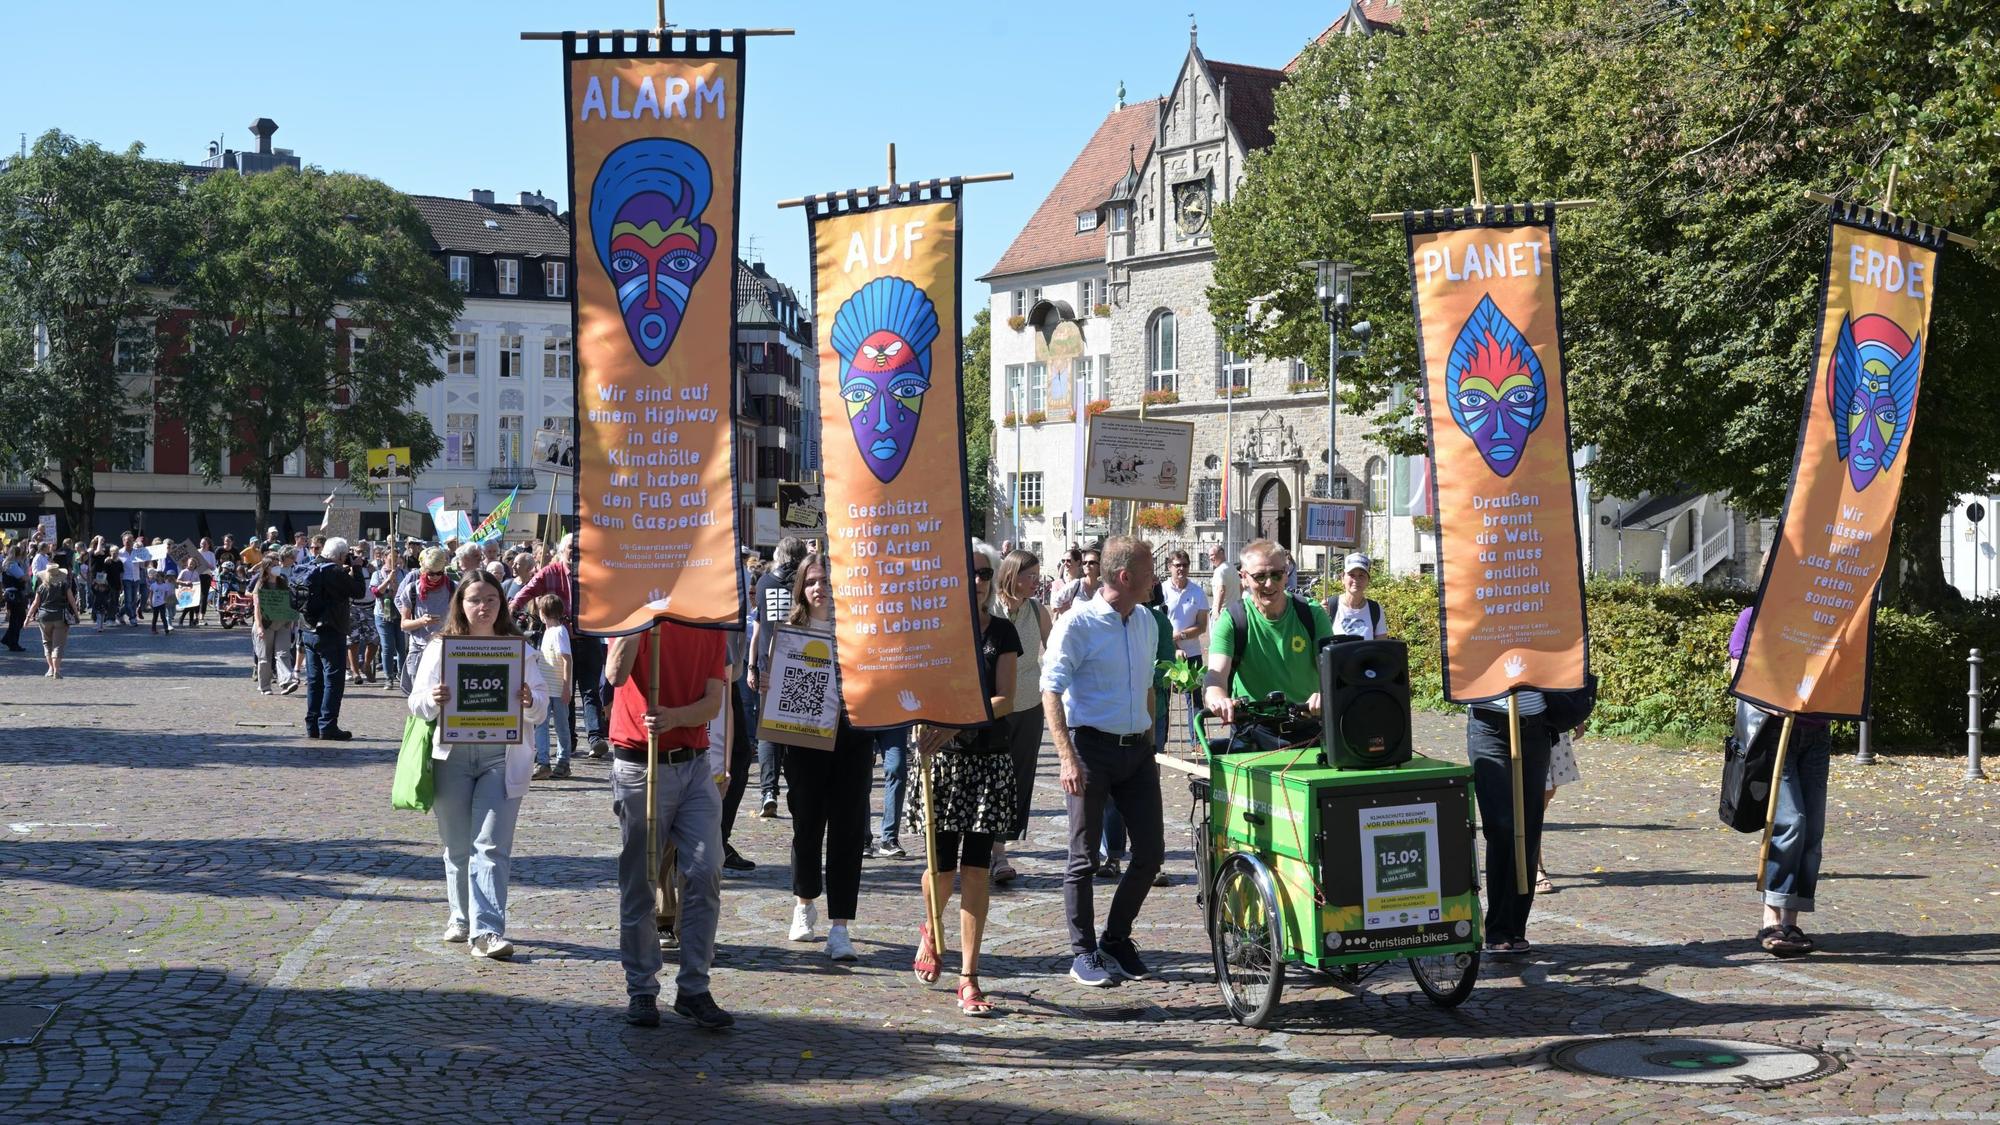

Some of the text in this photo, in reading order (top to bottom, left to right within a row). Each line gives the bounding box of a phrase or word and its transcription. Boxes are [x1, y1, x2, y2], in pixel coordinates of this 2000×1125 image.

[580, 75, 726, 121] ALARM
[843, 220, 926, 273] AUF
[1423, 241, 1543, 284] PLANET
[1849, 244, 1925, 298] ERDE
[597, 383, 710, 401] Wir sind auf
[588, 407, 718, 424] einem Highway
[628, 429, 679, 445] in die
[608, 449, 700, 466] Klimahölle
[610, 471, 698, 487] und haben
[602, 489, 708, 508] den Fuß auf
[1473, 493, 1540, 511] Draußen
[848, 500, 929, 519] Geschätzt
[1842, 503, 1864, 523] Wir
[592, 511, 719, 532] dem Gaspedal.
[838, 521, 909, 539] verlieren
[916, 518, 943, 533] wir
[1483, 512, 1534, 527] brennt
[1476, 528, 1544, 545] die Welt,
[1825, 522, 1872, 542] müssen
[850, 538, 931, 558] 150 Arten
[1479, 547, 1543, 563] da muss
[1829, 542, 1860, 558] nicht
[846, 556, 941, 579] pro Tag und
[1485, 564, 1539, 580] endlich
[837, 574, 959, 598] damit zerstören
[1475, 581, 1551, 600] gehandelt
[1814, 574, 1856, 594] retten,
[849, 594, 948, 617] wir das Netz
[1484, 601, 1544, 616] werden!
[1805, 591, 1855, 610] sondern
[855, 616, 944, 636] des Lebens.
[1812, 610, 1837, 626] uns.
[462, 678, 504, 690] 15.09.
[1382, 819, 1395, 827] DER
[1397, 817, 1429, 825] HAUSTÜR!
[1379, 849, 1422, 866] 15.09.
[1369, 932, 1449, 950] christiania bikes
